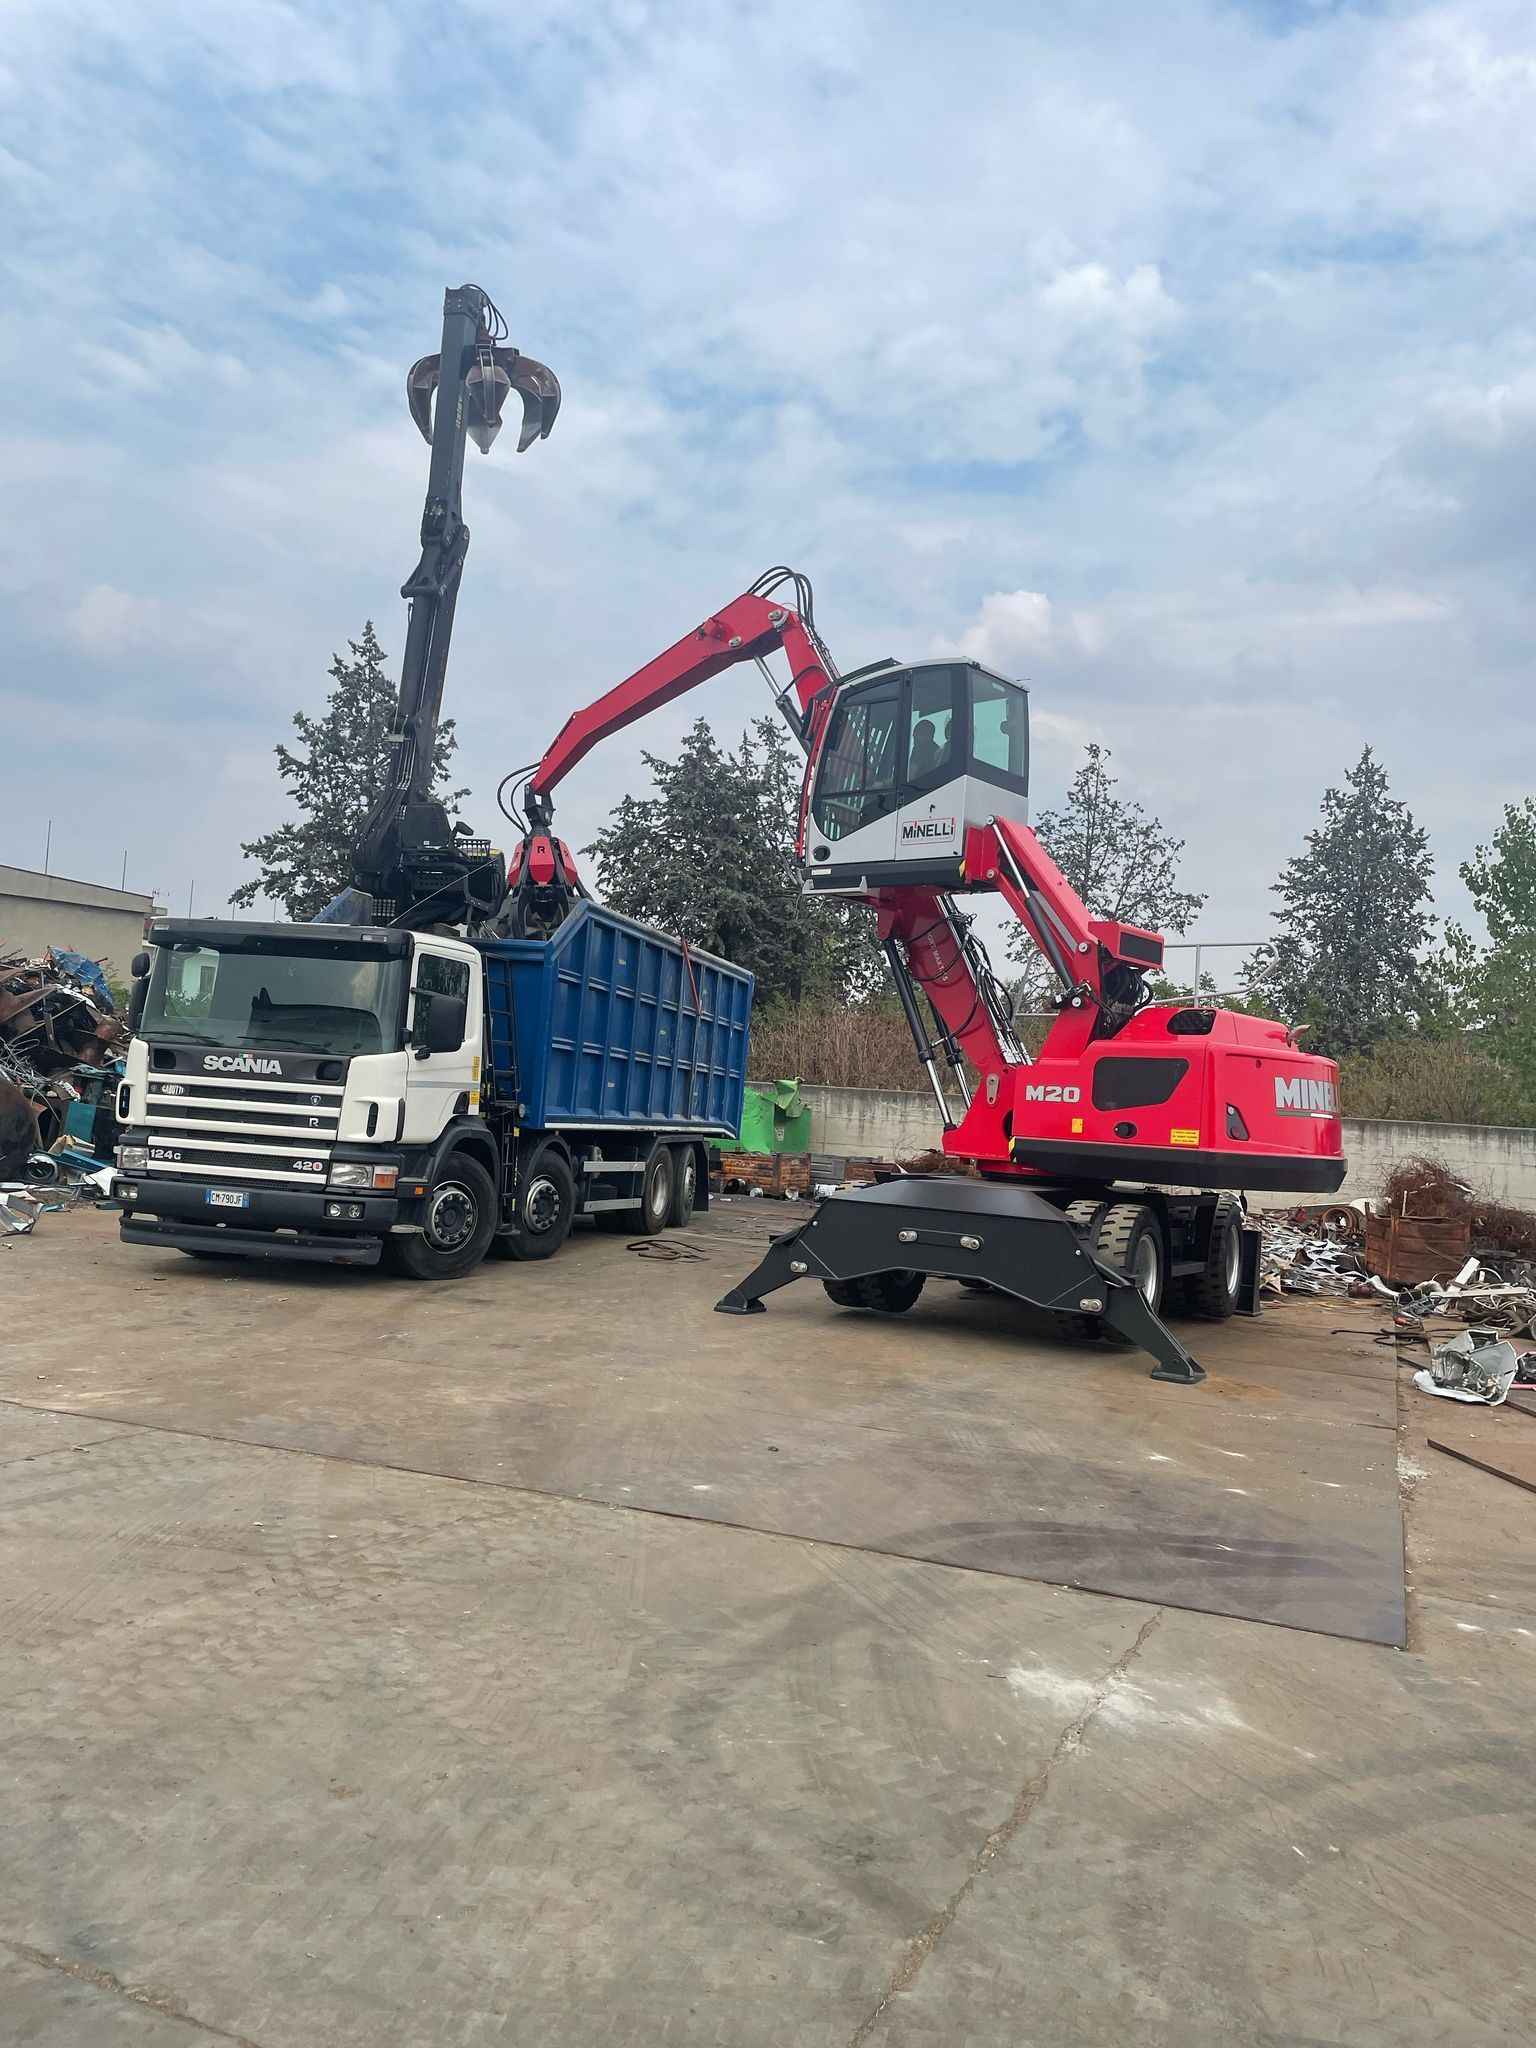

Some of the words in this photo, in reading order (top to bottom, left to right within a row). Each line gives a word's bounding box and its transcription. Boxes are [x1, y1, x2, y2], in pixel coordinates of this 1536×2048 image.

[203, 1055, 282, 1075] SCANIA
[1025, 1085, 1081, 1103] M20
[309, 1117, 319, 1127] R
[292, 1160, 323, 1172] 420
